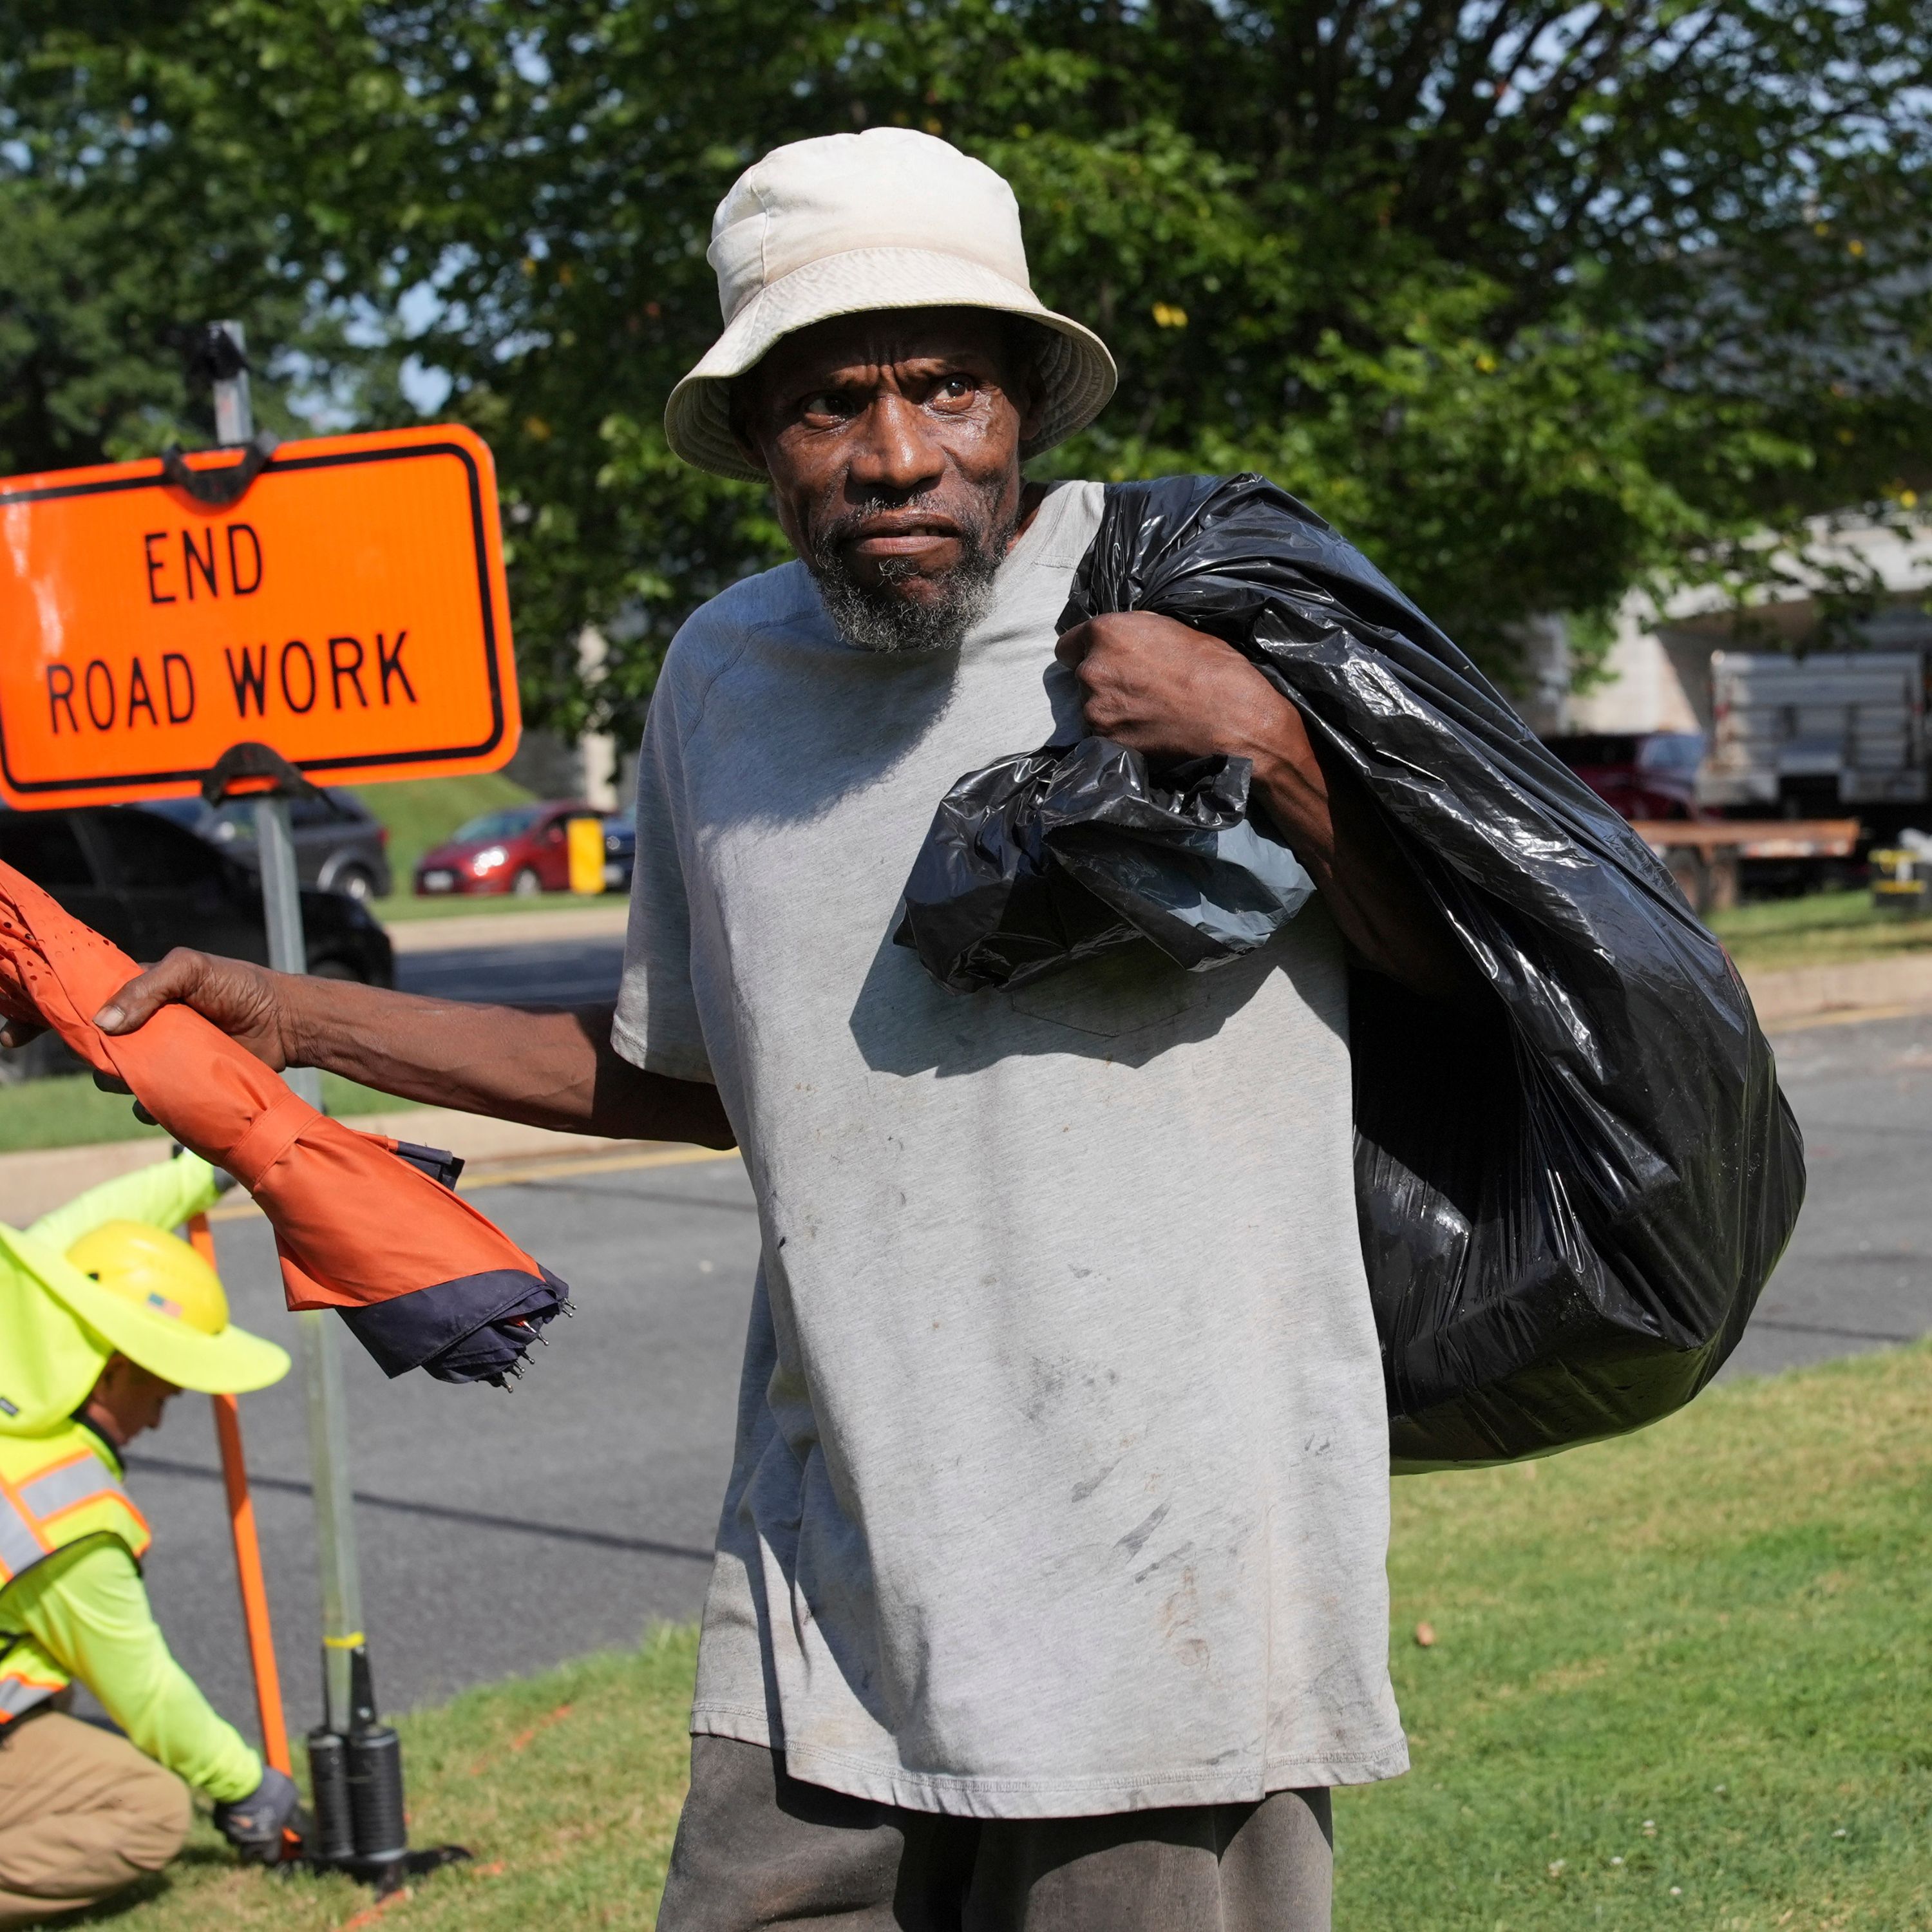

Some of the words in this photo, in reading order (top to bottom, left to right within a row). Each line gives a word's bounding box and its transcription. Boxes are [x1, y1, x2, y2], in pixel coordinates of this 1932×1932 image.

[145, 524, 263, 605] END
[47, 653, 195, 734] ROAD
[225, 631, 416, 718] WORK
